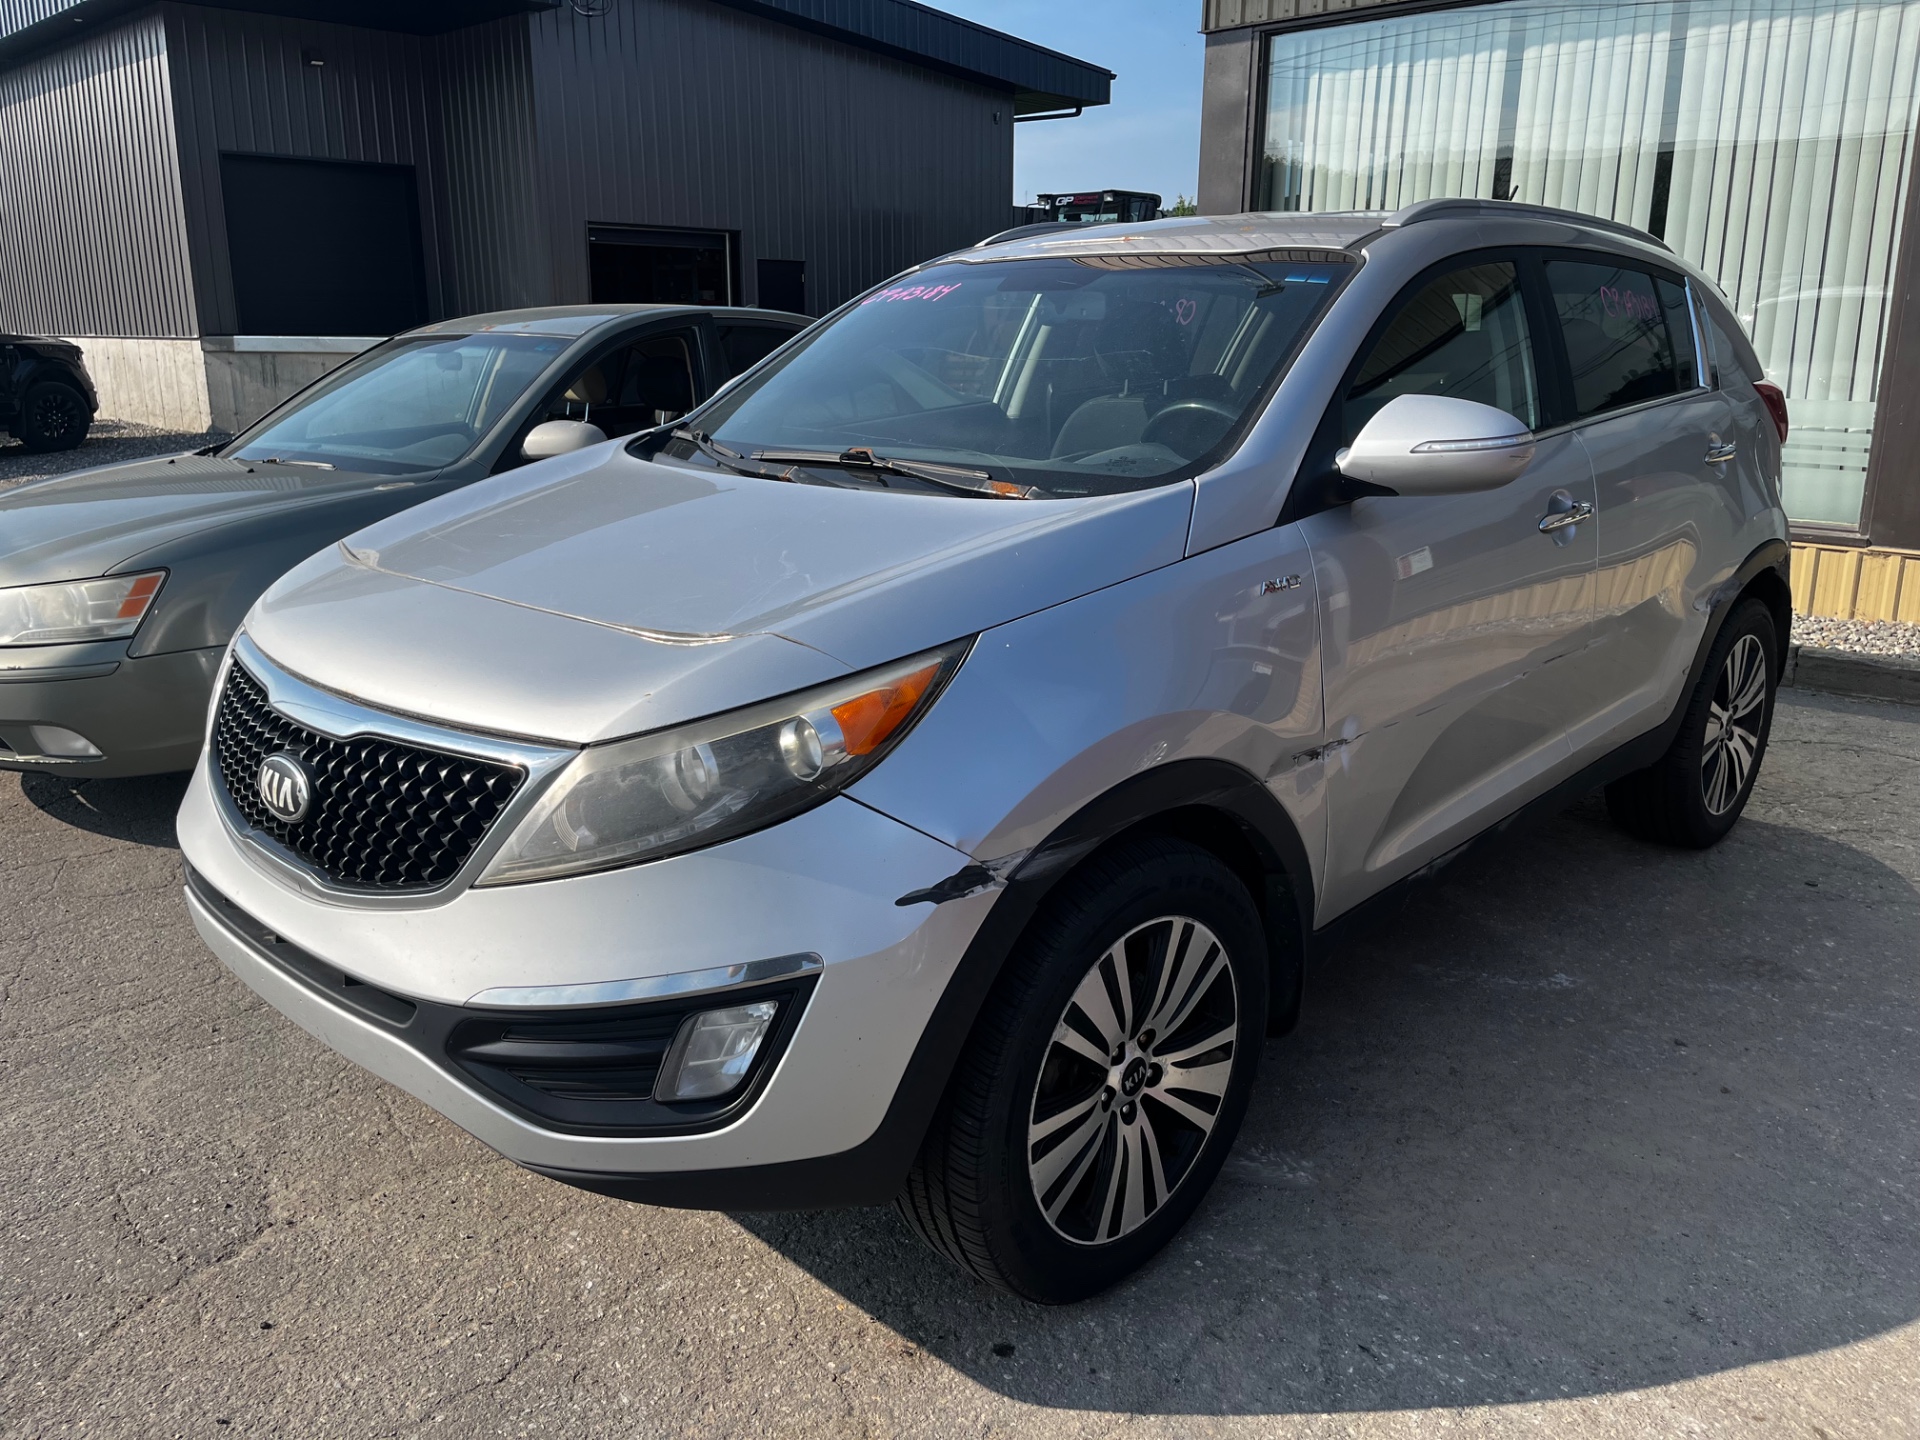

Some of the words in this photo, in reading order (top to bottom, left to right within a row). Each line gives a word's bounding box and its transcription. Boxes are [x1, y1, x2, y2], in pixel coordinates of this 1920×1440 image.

[1261, 574, 1302, 596] AWD
[260, 765, 296, 813] KIA
[1124, 1065, 1146, 1092] KIA
